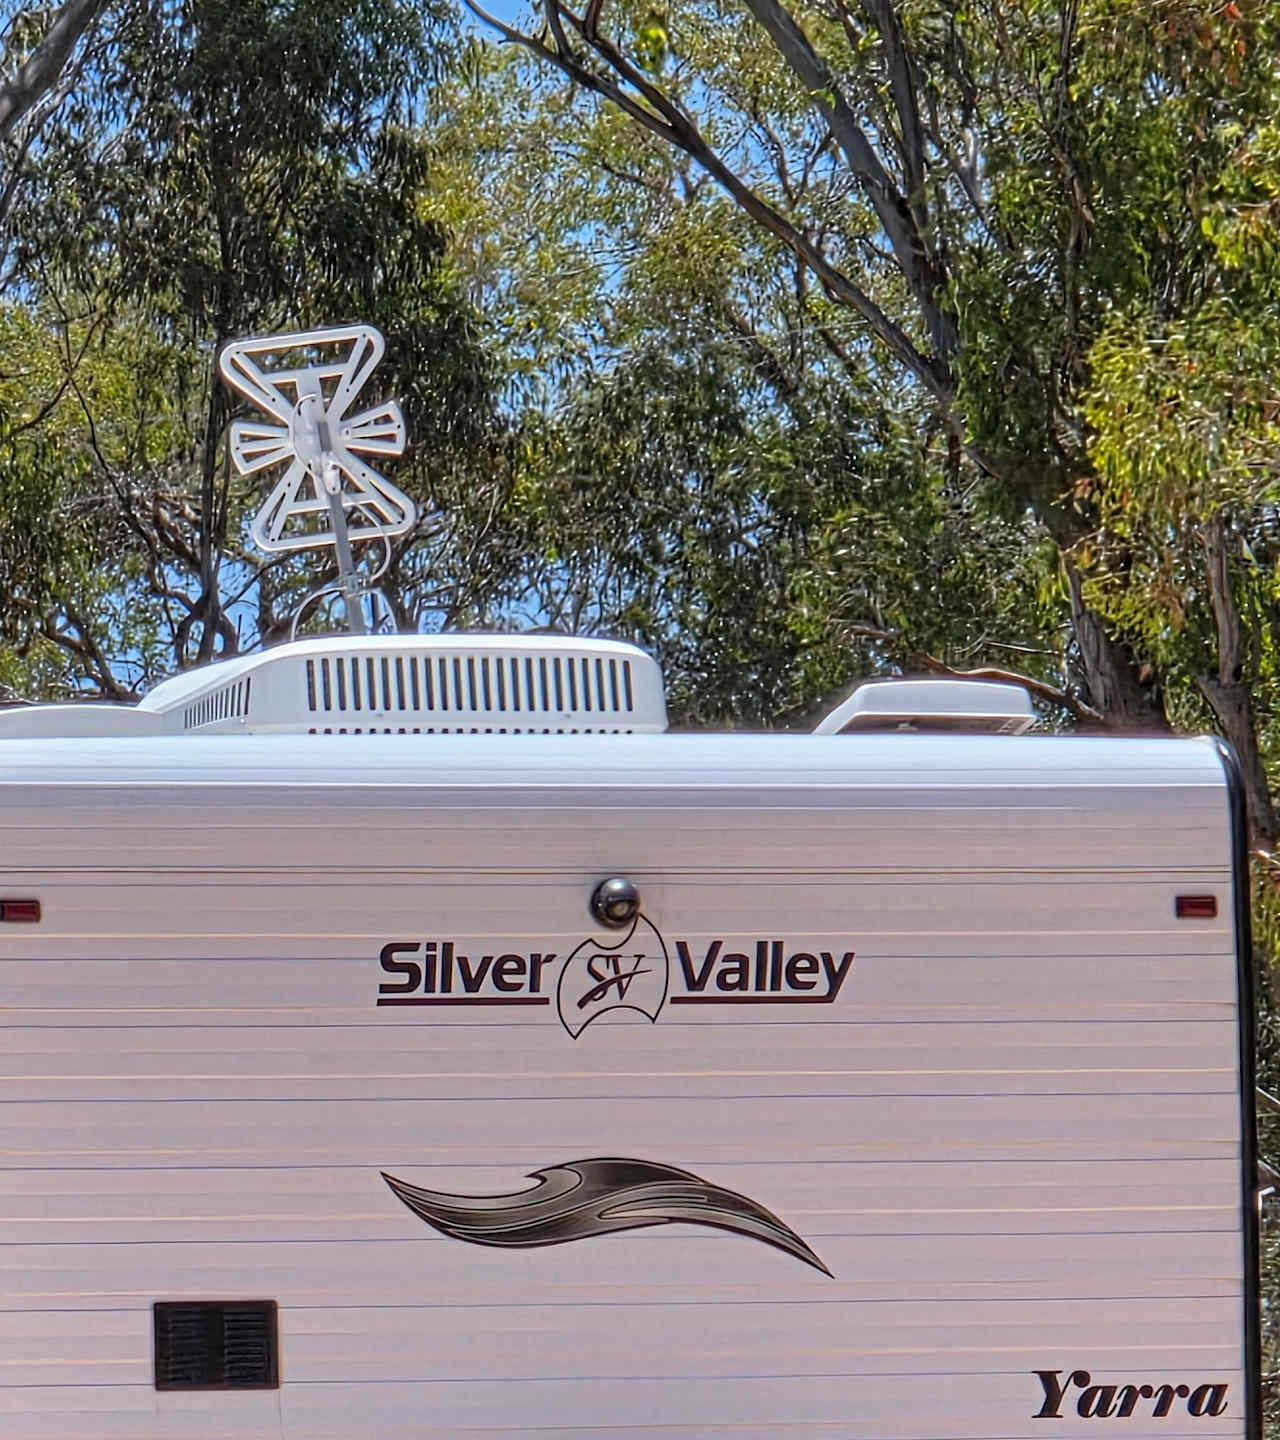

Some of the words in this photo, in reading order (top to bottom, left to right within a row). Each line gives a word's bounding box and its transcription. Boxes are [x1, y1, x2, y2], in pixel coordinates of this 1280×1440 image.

[378, 941, 557, 994] Silver
[676, 940, 855, 1003] Valley
[1031, 1369, 1229, 1419] Yarra
